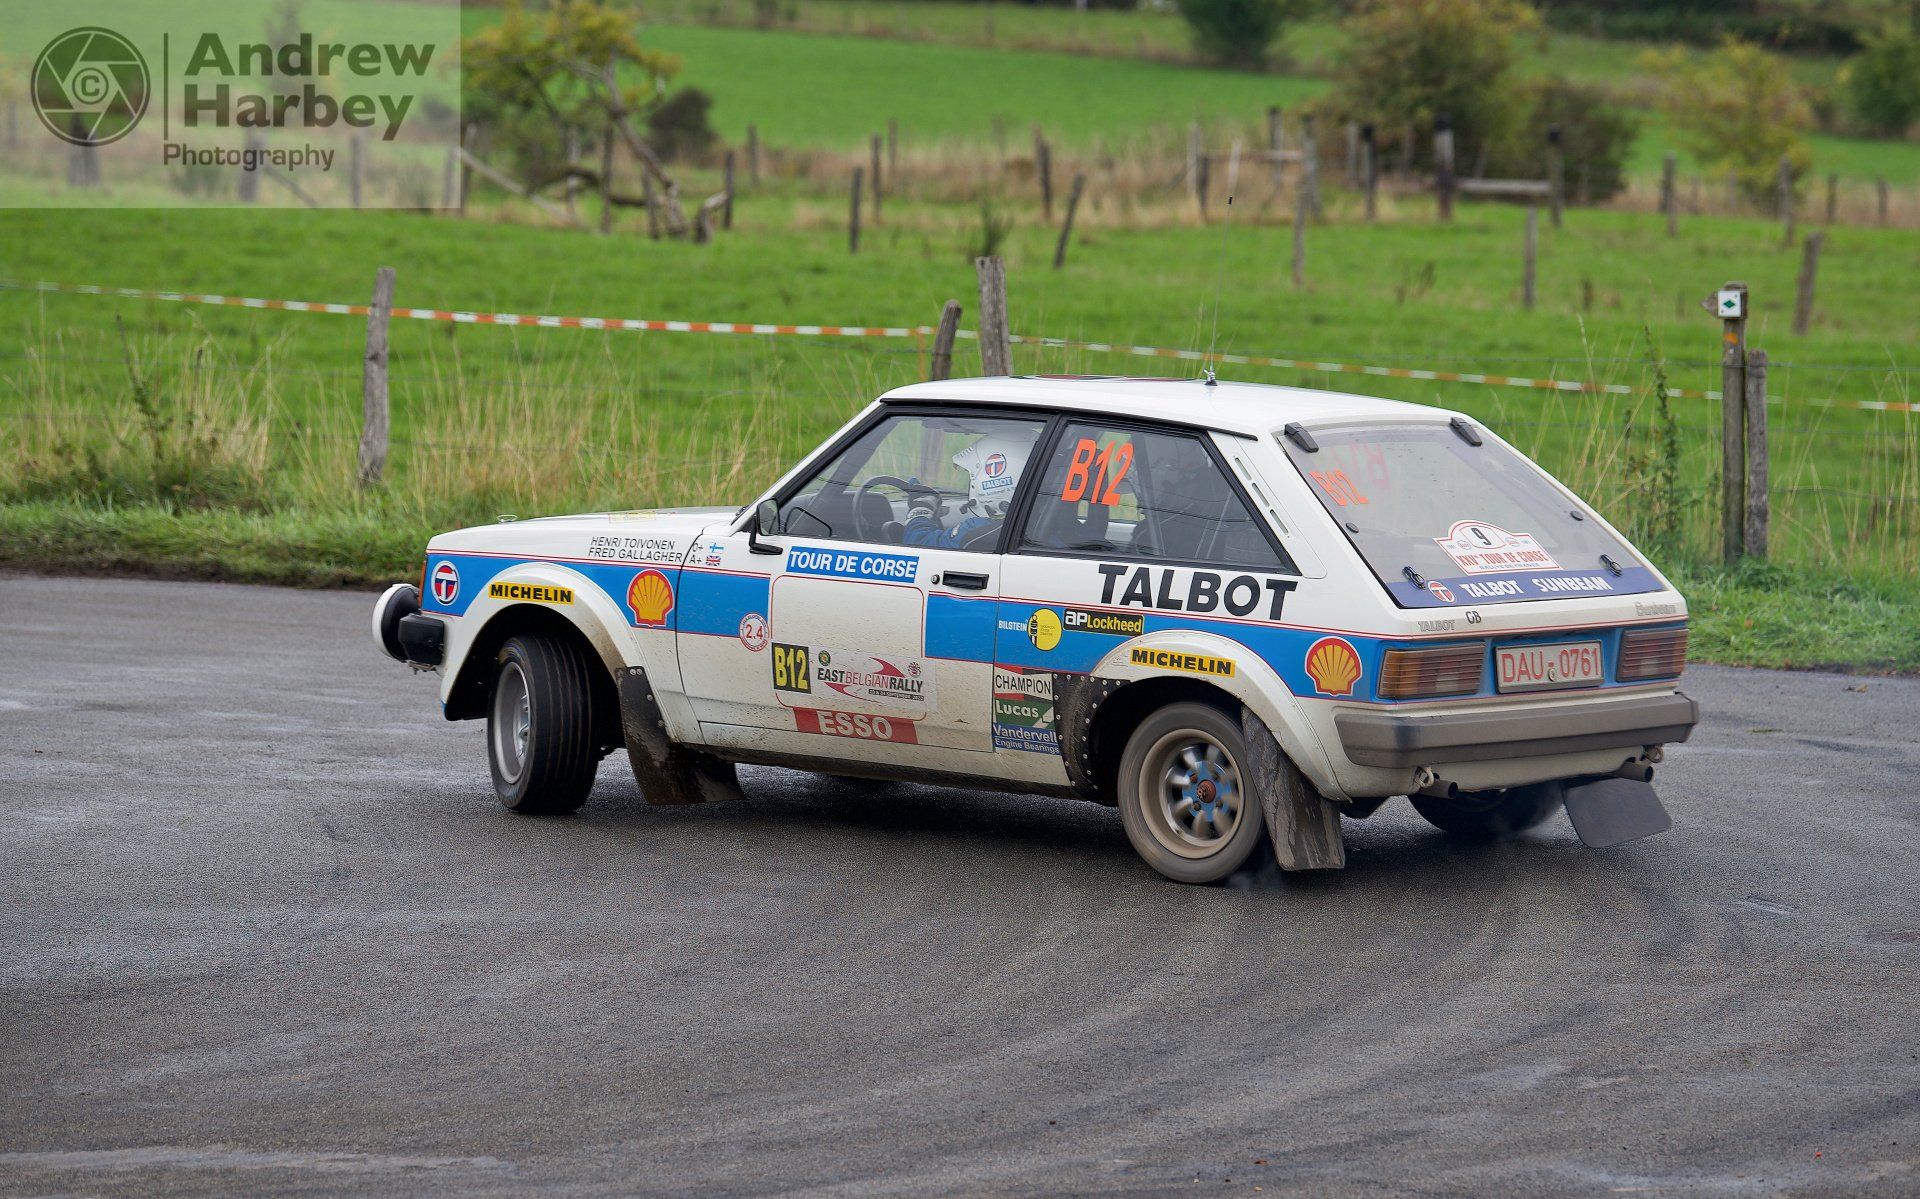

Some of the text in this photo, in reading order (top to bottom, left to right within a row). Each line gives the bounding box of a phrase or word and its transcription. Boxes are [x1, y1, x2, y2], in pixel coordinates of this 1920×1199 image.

[1062, 438, 1135, 507] B12
[982, 477, 1013, 490] TALBOT
[1309, 470, 1370, 507] B12
[591, 536, 621, 548] HENRI
[624, 537, 676, 550] TOIVONEN
[1471, 527, 1492, 546] 9
[588, 547, 702, 564] FRED GALLAGHER A+
[789, 550, 918, 578] TOUR DE CORSE
[1479, 552, 1507, 565] TOUR
[1504, 551, 1518, 563] DE
[1517, 550, 1549, 562] CORSE
[490, 584, 573, 603] MICHELIN
[1098, 563, 1298, 621] TALBOT
[1459, 576, 1613, 598] TALBOT SUNBEAM
[998, 620, 1028, 632] BILSTEIN
[1417, 619, 1455, 632] TALBOT
[774, 646, 809, 690] B12
[1132, 649, 1233, 675] MICHELIN
[995, 674, 1051, 695] CHAMPION
[995, 700, 1039, 718] Lucas
[816, 710, 893, 740] ESSO
[993, 724, 1058, 743] Vandervell
[994, 738, 1060, 754] Engine Bearings
